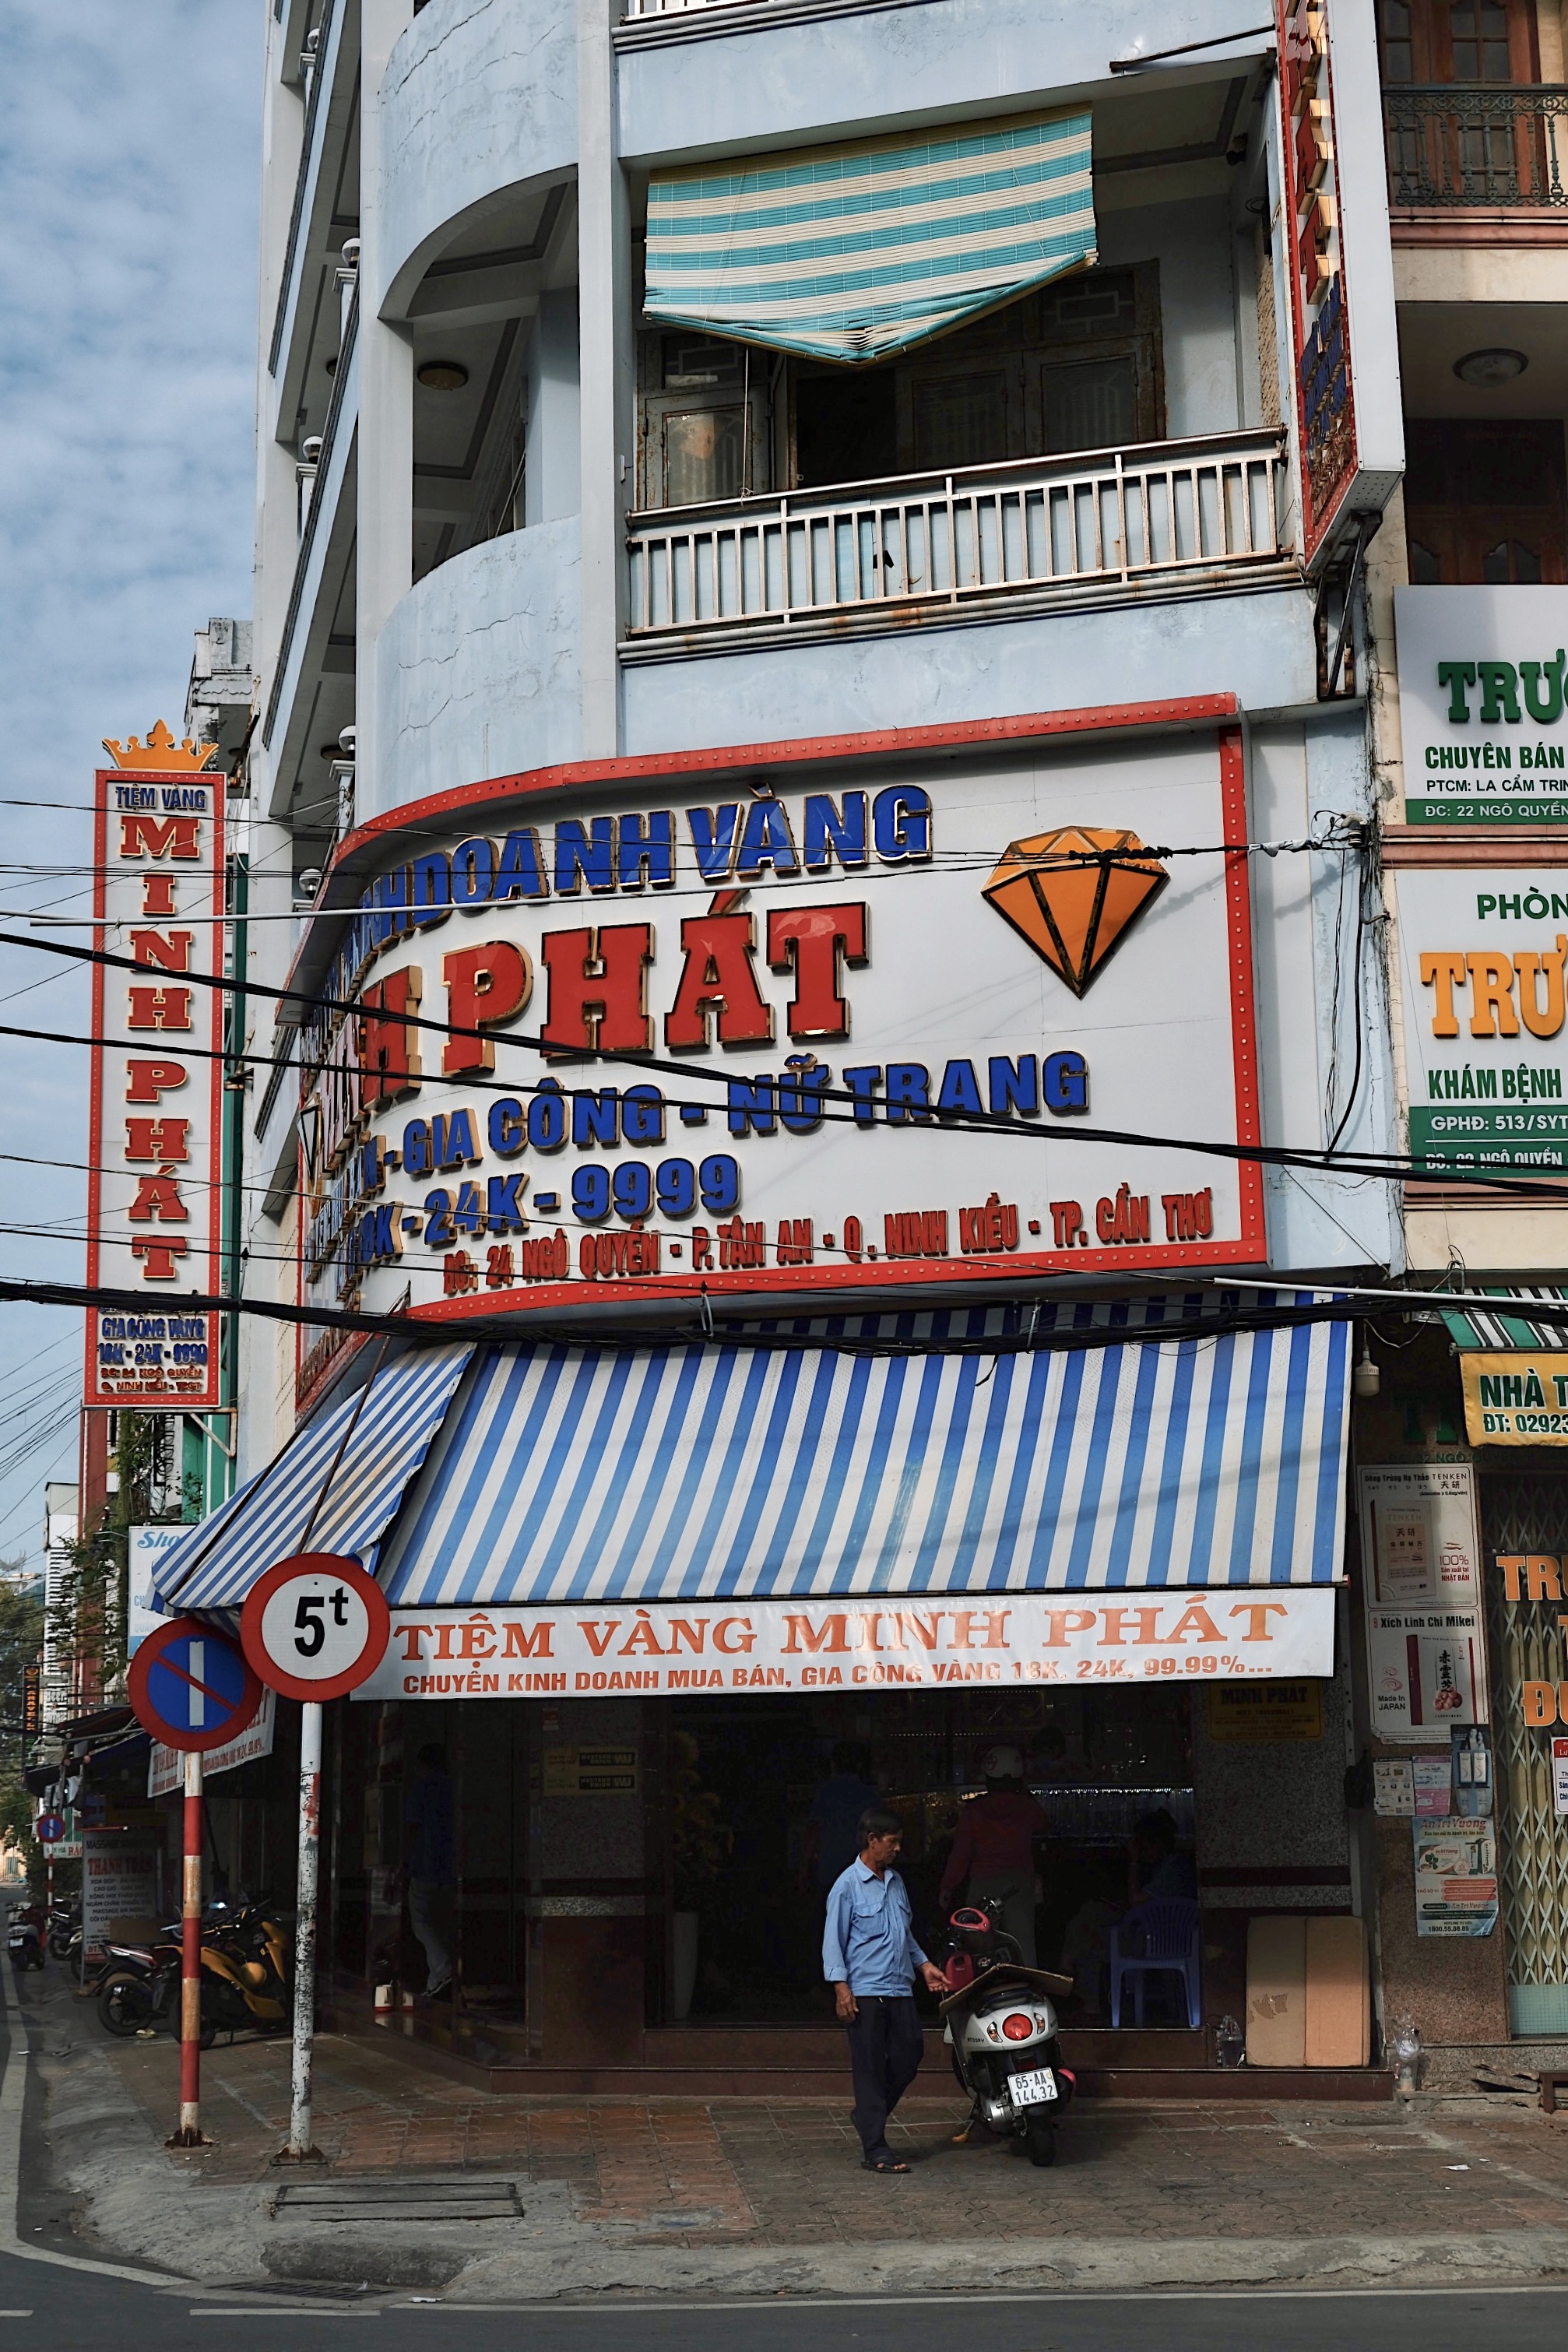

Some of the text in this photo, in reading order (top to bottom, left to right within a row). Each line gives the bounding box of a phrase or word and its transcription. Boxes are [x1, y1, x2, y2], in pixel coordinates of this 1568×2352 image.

[1438, 649, 1568, 724] TRƯ
[1425, 742, 1565, 769] CHUYÊN BÁN
[1426, 779, 1471, 792] PTCM:
[1476, 780, 1496, 792] LA
[1501, 774, 1535, 792] CẨM
[116, 782, 207, 814] TIỆM VÀNG
[1425, 805, 1450, 817] ĐC:
[1457, 805, 1474, 817] 22
[1480, 803, 1513, 817] NGÔ
[413, 782, 933, 930] DOANH VÀNG
[1477, 886, 1568, 919] PHÒN
[119, 816, 200, 1029] MINH
[441, 890, 870, 1076] PHÁT
[1421, 934, 1568, 1039] TRƯ
[1429, 1063, 1562, 1104] KHÁM BỆNH
[403, 1050, 1089, 1176] GIA CÔNG NỮ TRANG
[1431, 1116, 1489, 1132] GPHĐ:
[124, 1060, 189, 1279] PHÁT
[1514, 1146, 1563, 1172] QUYỀN
[424, 1172, 530, 1247] 24K
[571, 1154, 742, 1222] 9999
[486, 1244, 514, 1286] 24
[522, 1228, 569, 1281] NGÔ
[579, 1217, 661, 1280] QUYỀN
[777, 1218, 813, 1265] AN
[884, 1210, 948, 1260] NINH
[958, 1192, 1018, 1253] KIỀU
[1049, 1200, 1088, 1247] TP.
[1096, 1183, 1150, 1244] CẦN
[1162, 1187, 1213, 1241] THƠ
[102, 1317, 126, 1339] GIA
[127, 1314, 166, 1339] CÔNG
[97, 1342, 208, 1366] 18K 24K 9999
[167, 1364, 202, 1378] QUYỀN
[117, 1381, 143, 1391] NINH
[1480, 1368, 1545, 1408] NHÀ
[1483, 1413, 1511, 1433] ĐT:
[1436, 1450, 1467, 1464] NGÔ
[1440, 1555, 1470, 1566] 100%
[1457, 1573, 1470, 1582] BẢN
[393, 1594, 1289, 1668] TIỆM VÀNG MINH PHÁT
[1381, 1615, 1475, 1629] Xích Linh Chi Mikei
[403, 1654, 1273, 1694] CHUYÊN KINH DOANH MUA BÁN, GIA CÔNG VÀNG 18K, 24K, 99.99%...
[1221, 1683, 1308, 1705] MINH PHÁT
[1015, 2072, 1047, 2090] 65-AA
[1015, 2085, 1055, 2104] 144.32
